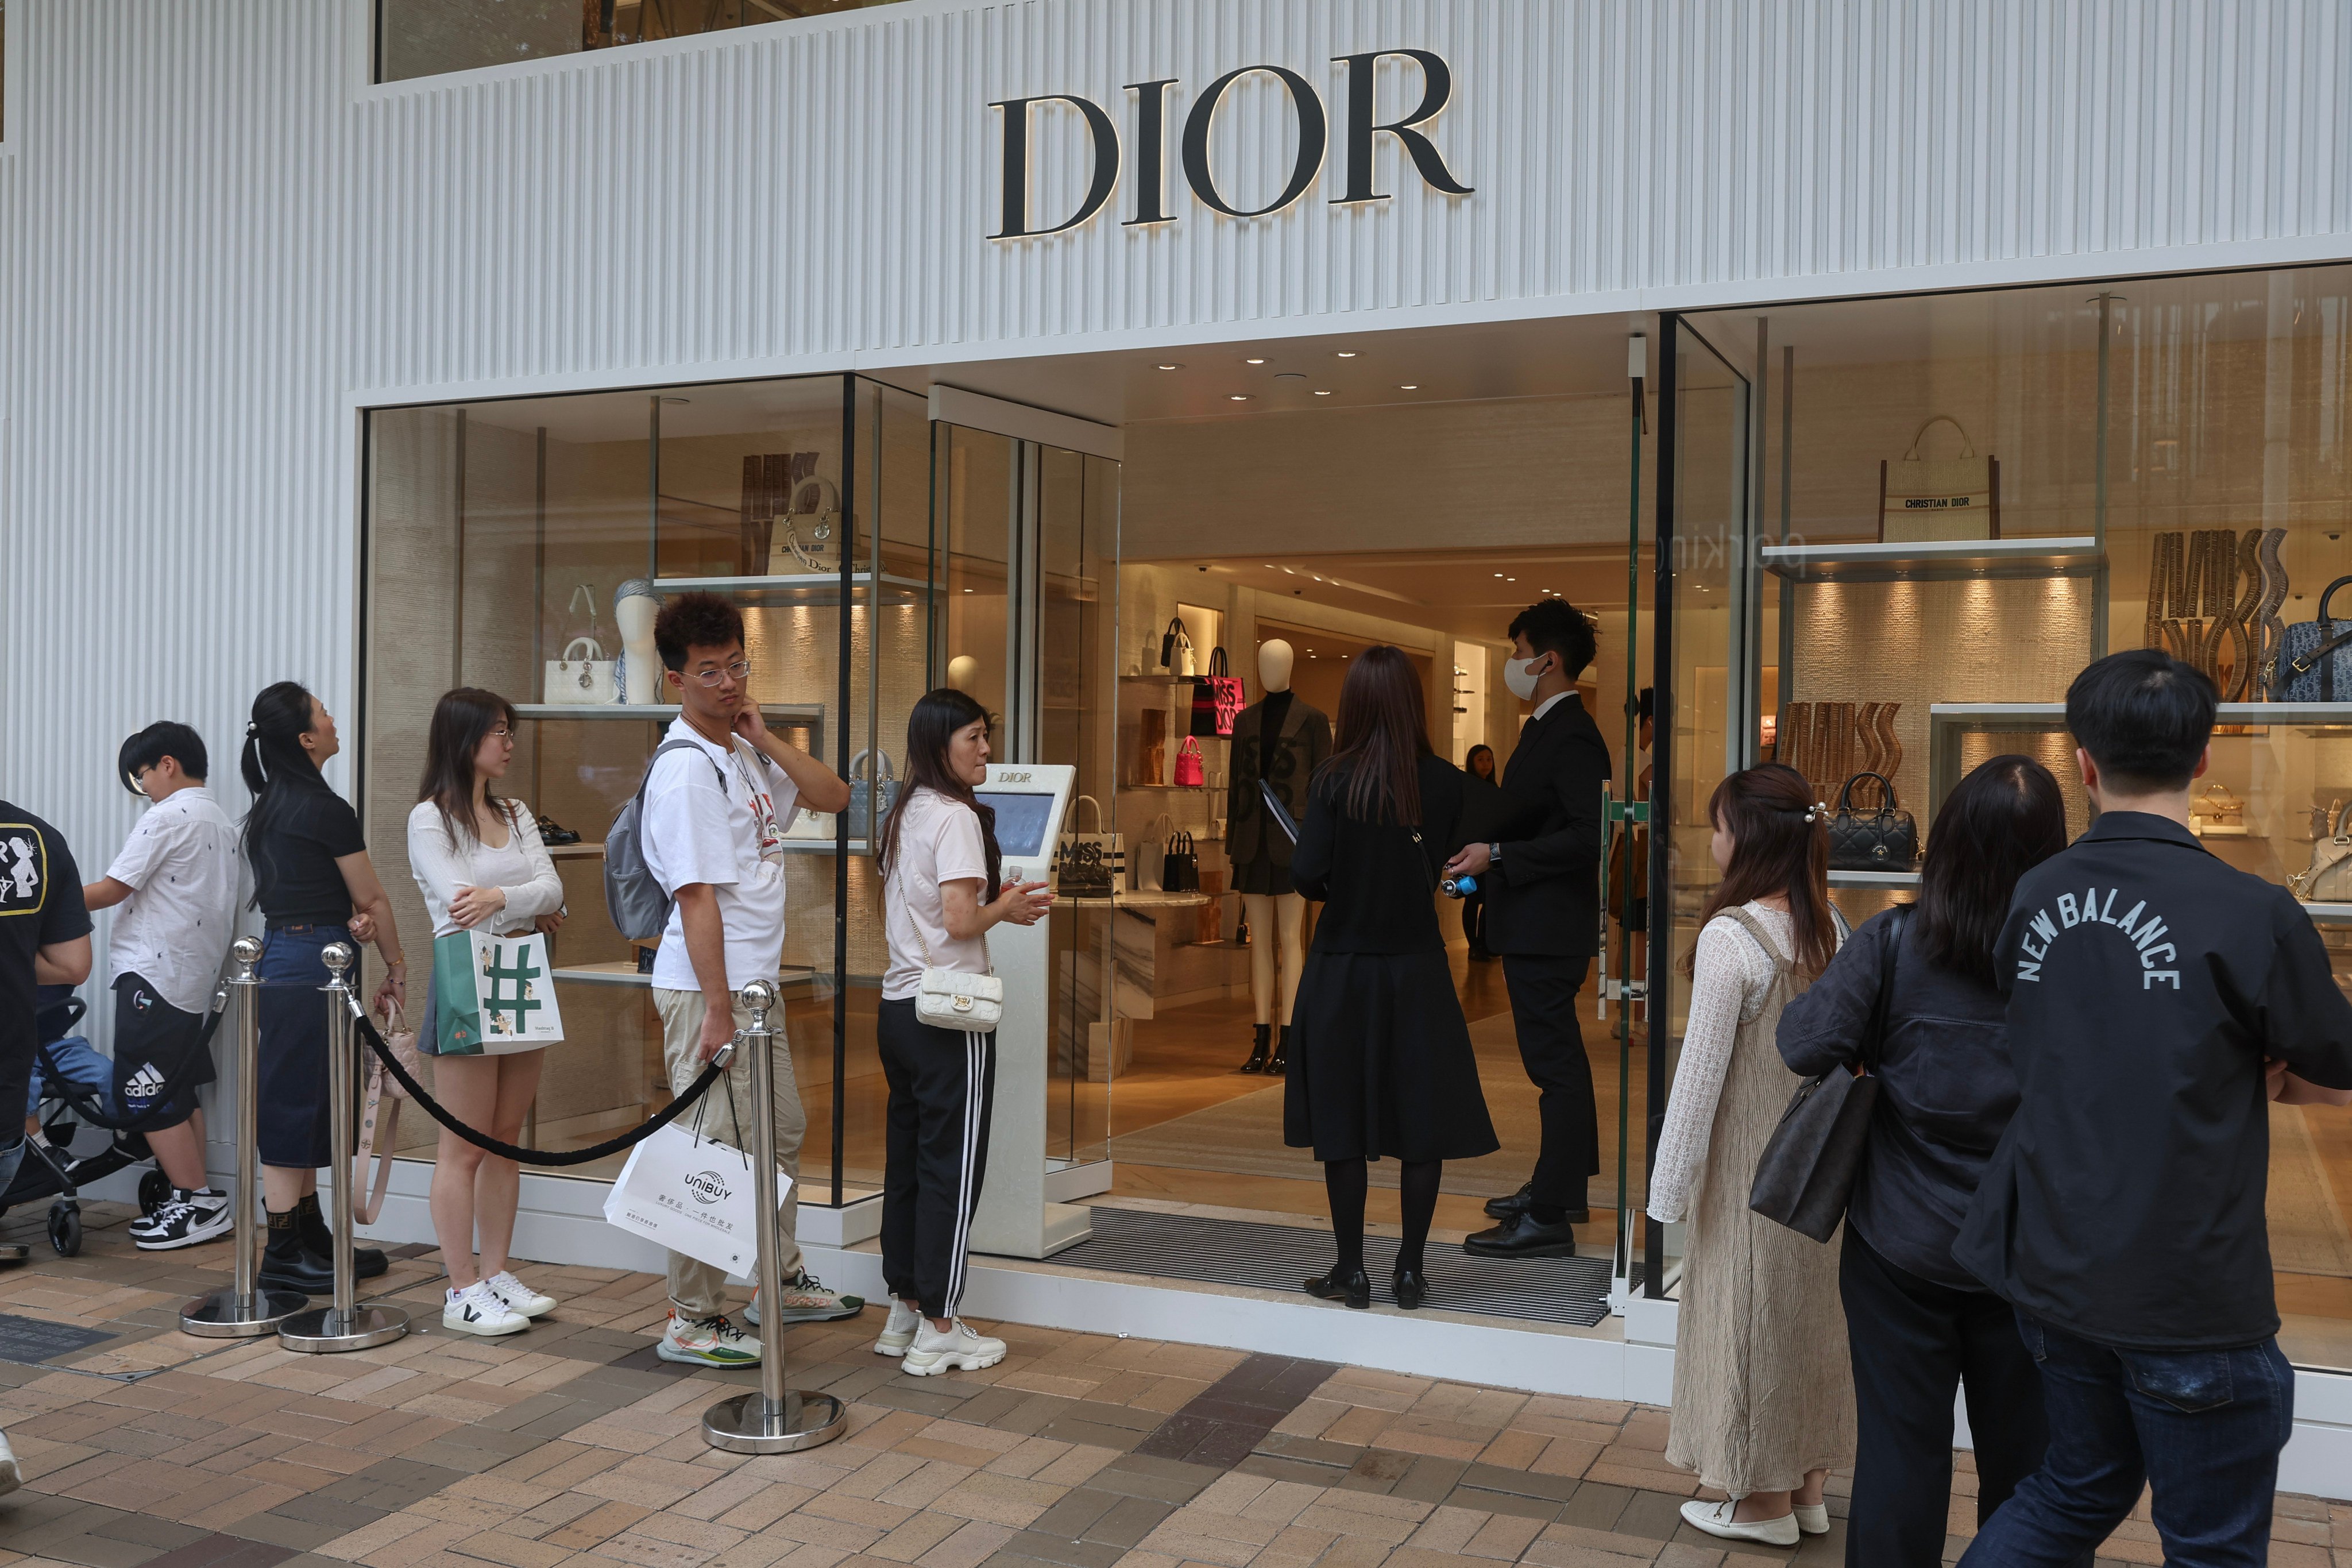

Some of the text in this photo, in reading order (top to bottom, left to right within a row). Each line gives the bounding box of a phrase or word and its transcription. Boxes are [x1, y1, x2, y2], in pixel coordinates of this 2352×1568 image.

[986, 49, 1476, 240] DIOR
[1905, 497, 1970, 508] CHRISTIAN DIOR
[782, 544, 809, 553] CHIAN
[808, 558, 832, 573] Dior
[998, 772, 1032, 783] DIOR
[2017, 887, 2180, 990] NEW BALANCE
[125, 1082, 164, 1097] adida
[655, 1200, 669, 1210] LUXURY
[670, 1207, 682, 1215] GOODS
[710, 1222, 731, 1235] WHOLESALE
